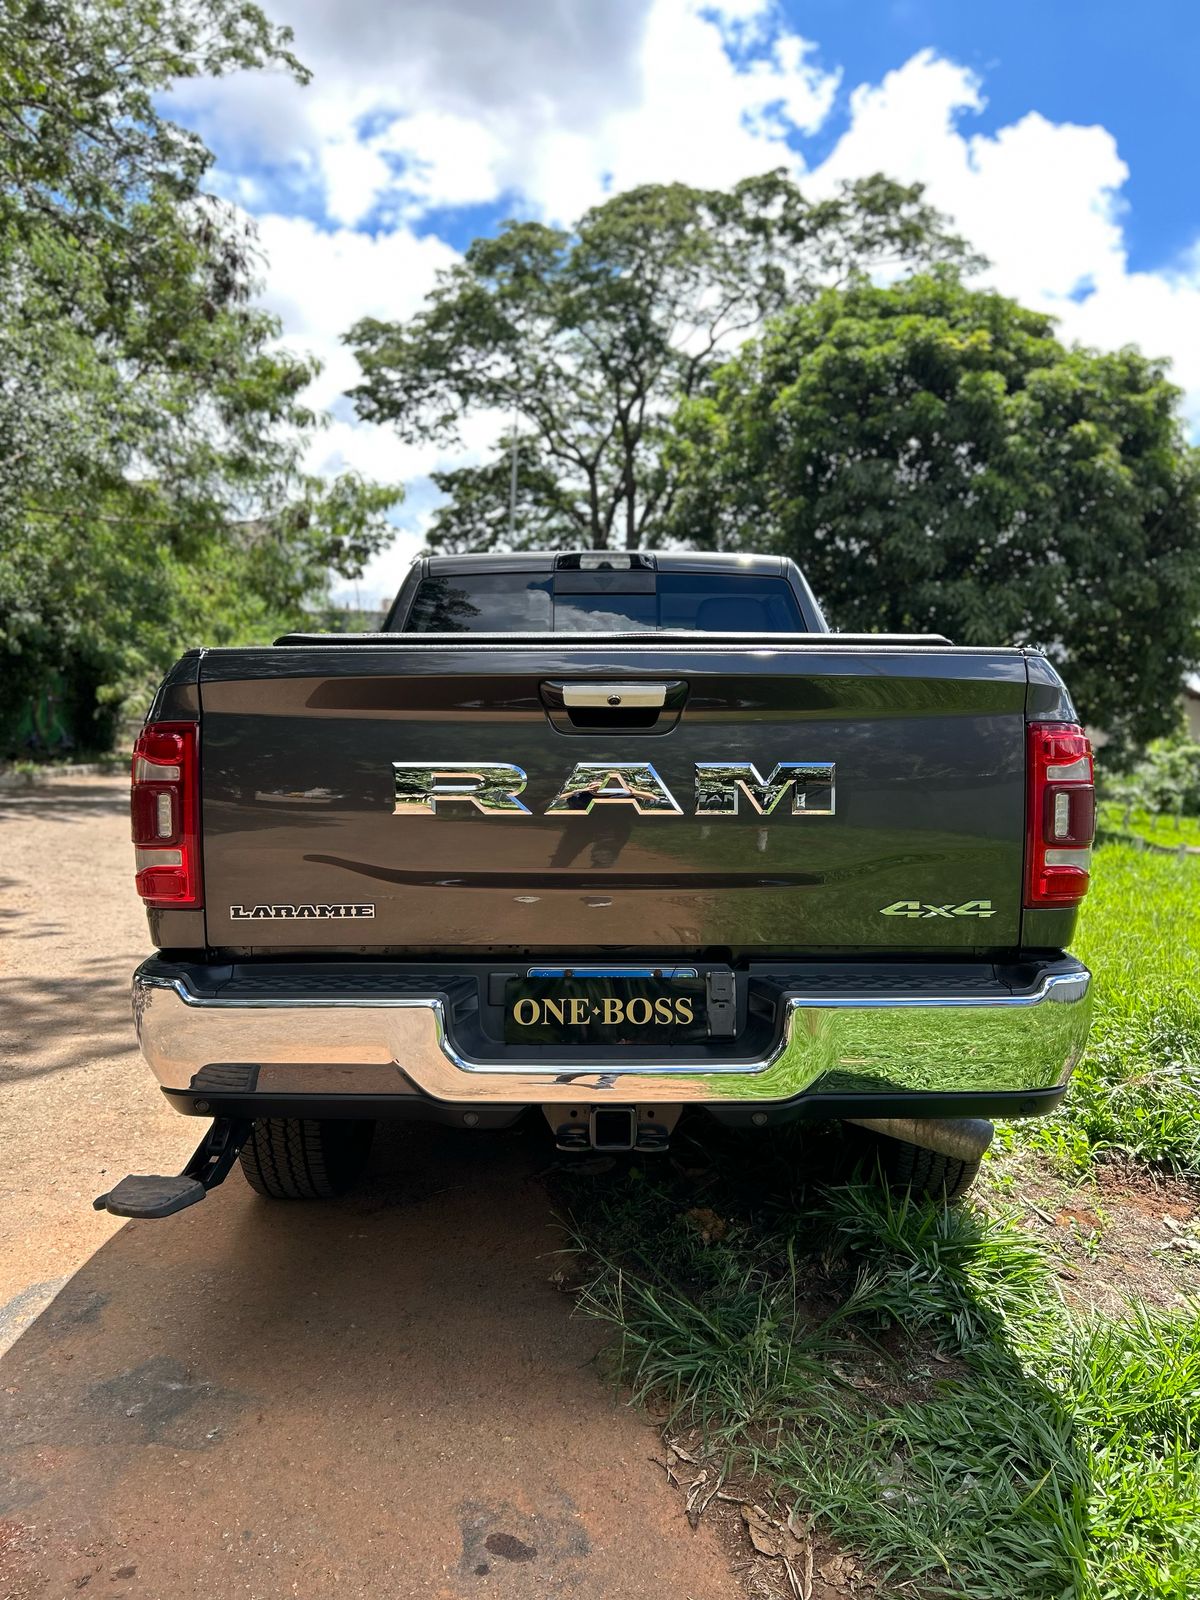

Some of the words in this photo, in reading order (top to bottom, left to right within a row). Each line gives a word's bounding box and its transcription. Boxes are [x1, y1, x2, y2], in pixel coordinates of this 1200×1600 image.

[392, 762, 836, 815] RAM
[230, 904, 375, 920] LARAMIE
[880, 900, 997, 918] 4x4
[513, 998, 590, 1025] ONE
[601, 997, 694, 1025] BOSS
